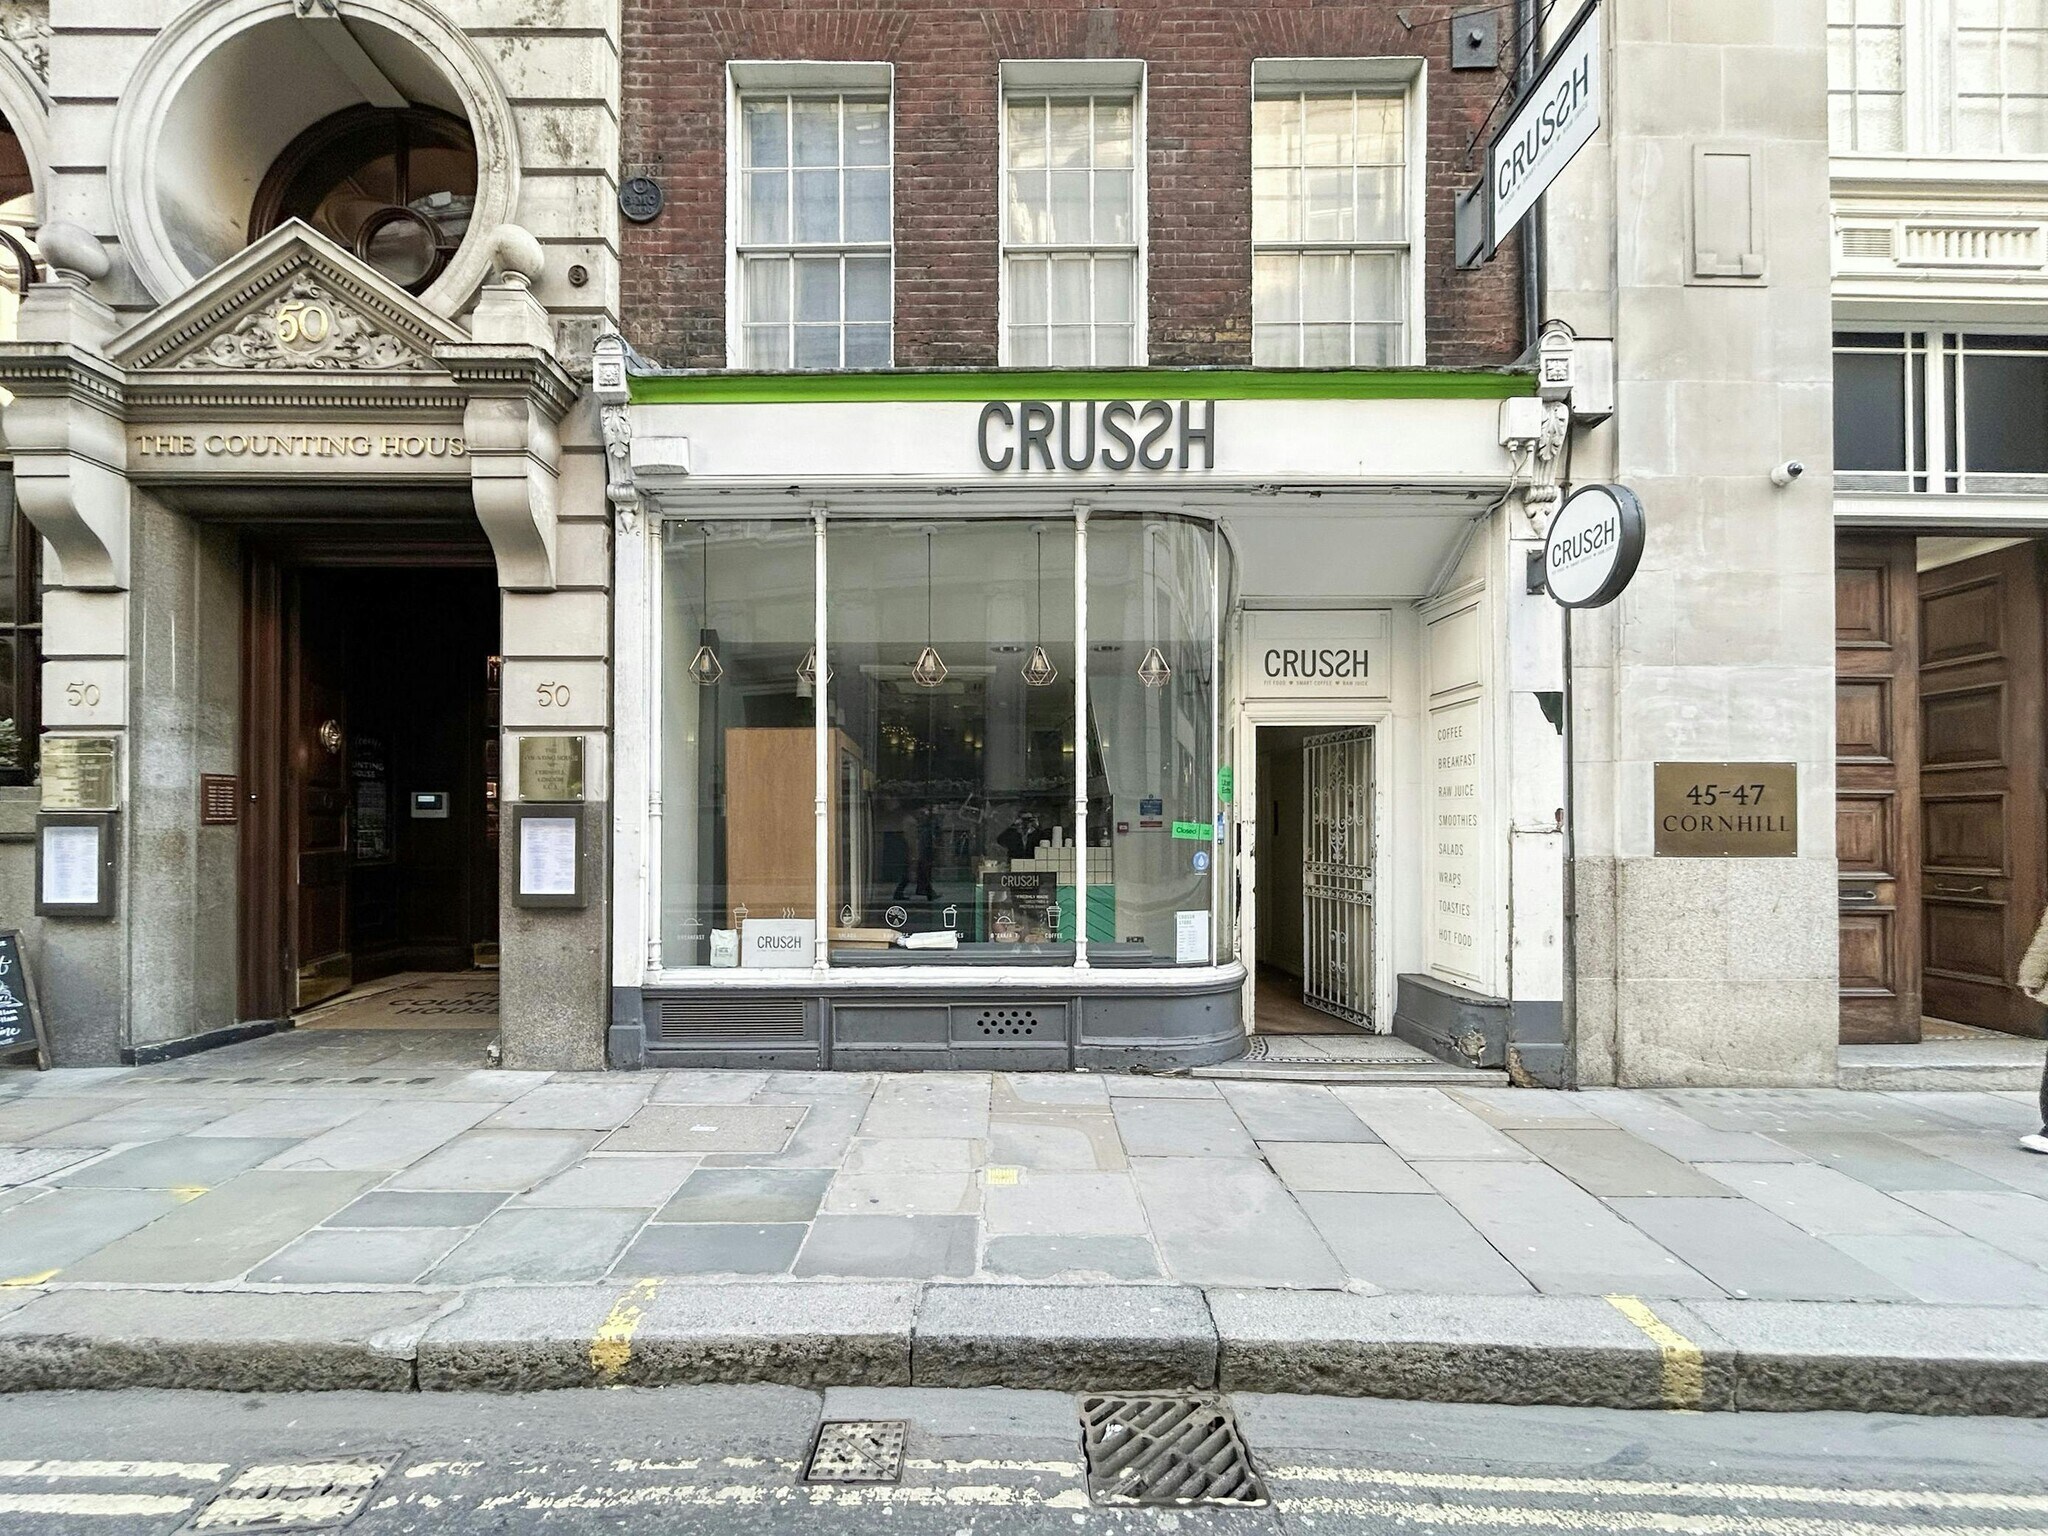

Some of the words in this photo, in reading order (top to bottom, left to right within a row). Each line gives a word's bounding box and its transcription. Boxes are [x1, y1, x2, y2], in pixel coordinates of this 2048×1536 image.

[1499, 52, 1589, 200] CRUSSH
[275, 302, 329, 343] 50
[978, 400, 1215, 471] CRUSSH
[136, 435, 196, 457] THE
[205, 435, 371, 457] COUNTING
[380, 435, 466, 458] HOUS
[1552, 516, 1615, 568] CRUSSH
[1264, 649, 1368, 677] CRUSSH
[66, 680, 100, 706] 50
[536, 681, 570, 707] 50
[1437, 725, 1463, 741] COFFEE
[1438, 753, 1476, 769] BREAKFAST
[1438, 786, 1452, 797] RAW
[1454, 784, 1474, 797] JUICE
[1686, 784, 1765, 806] 45-47
[1438, 814, 1477, 826] SMOOTHIES
[1663, 815, 1790, 832] CORNHILL
[1176, 827, 1197, 835] Closed
[1438, 843, 1464, 856] SALADS
[1001, 875, 1039, 887] CRUSSH
[1438, 871, 1461, 885] WRAPS
[1438, 900, 1470, 917] TOASTIES
[757, 935, 802, 949] CRUSSH
[1438, 928, 1451, 941] HOT
[1453, 932, 1473, 947] FOOD
